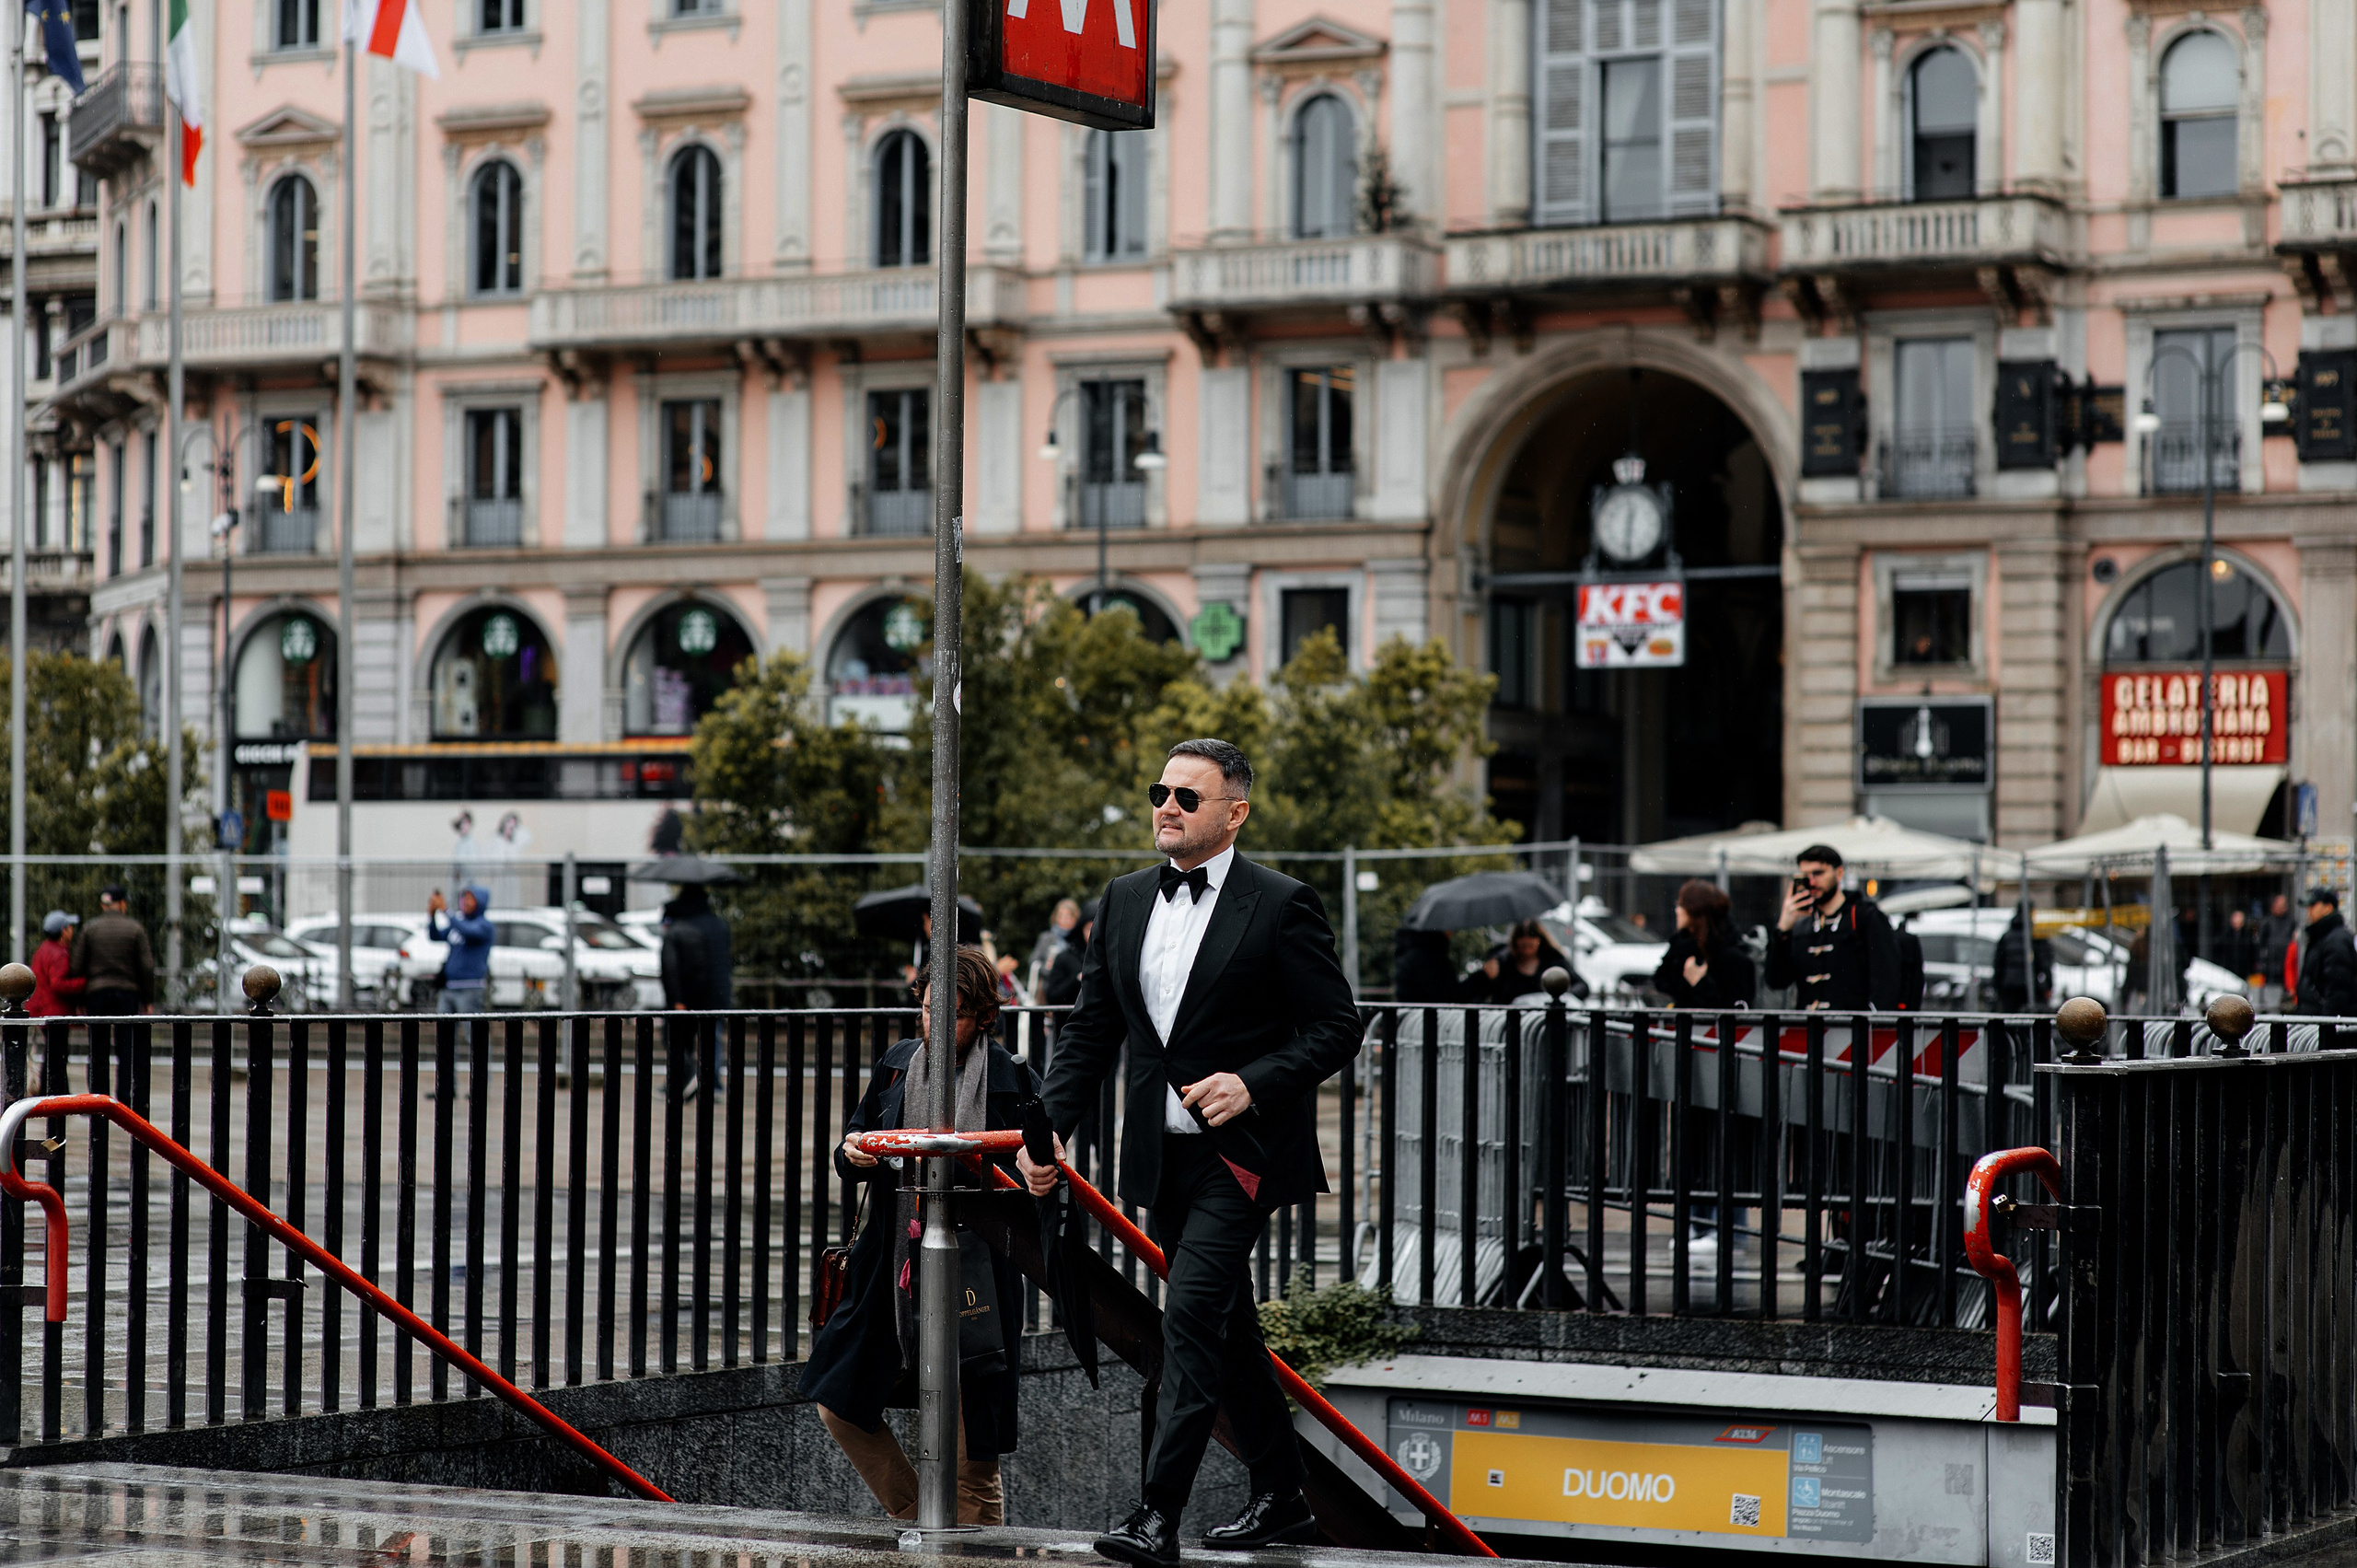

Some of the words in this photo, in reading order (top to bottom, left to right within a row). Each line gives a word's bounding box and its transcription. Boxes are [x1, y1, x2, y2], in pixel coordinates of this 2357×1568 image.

[1585, 583, 1681, 624] KFC
[2117, 738, 2159, 763] BAR
[1398, 1410, 1445, 1424] Milano
[1823, 1445, 1865, 1455] Ascensore
[1562, 1468, 1675, 1503] DUOMO
[1821, 1488, 1866, 1499] Montascale
[1816, 1509, 1840, 1518] Duomo
